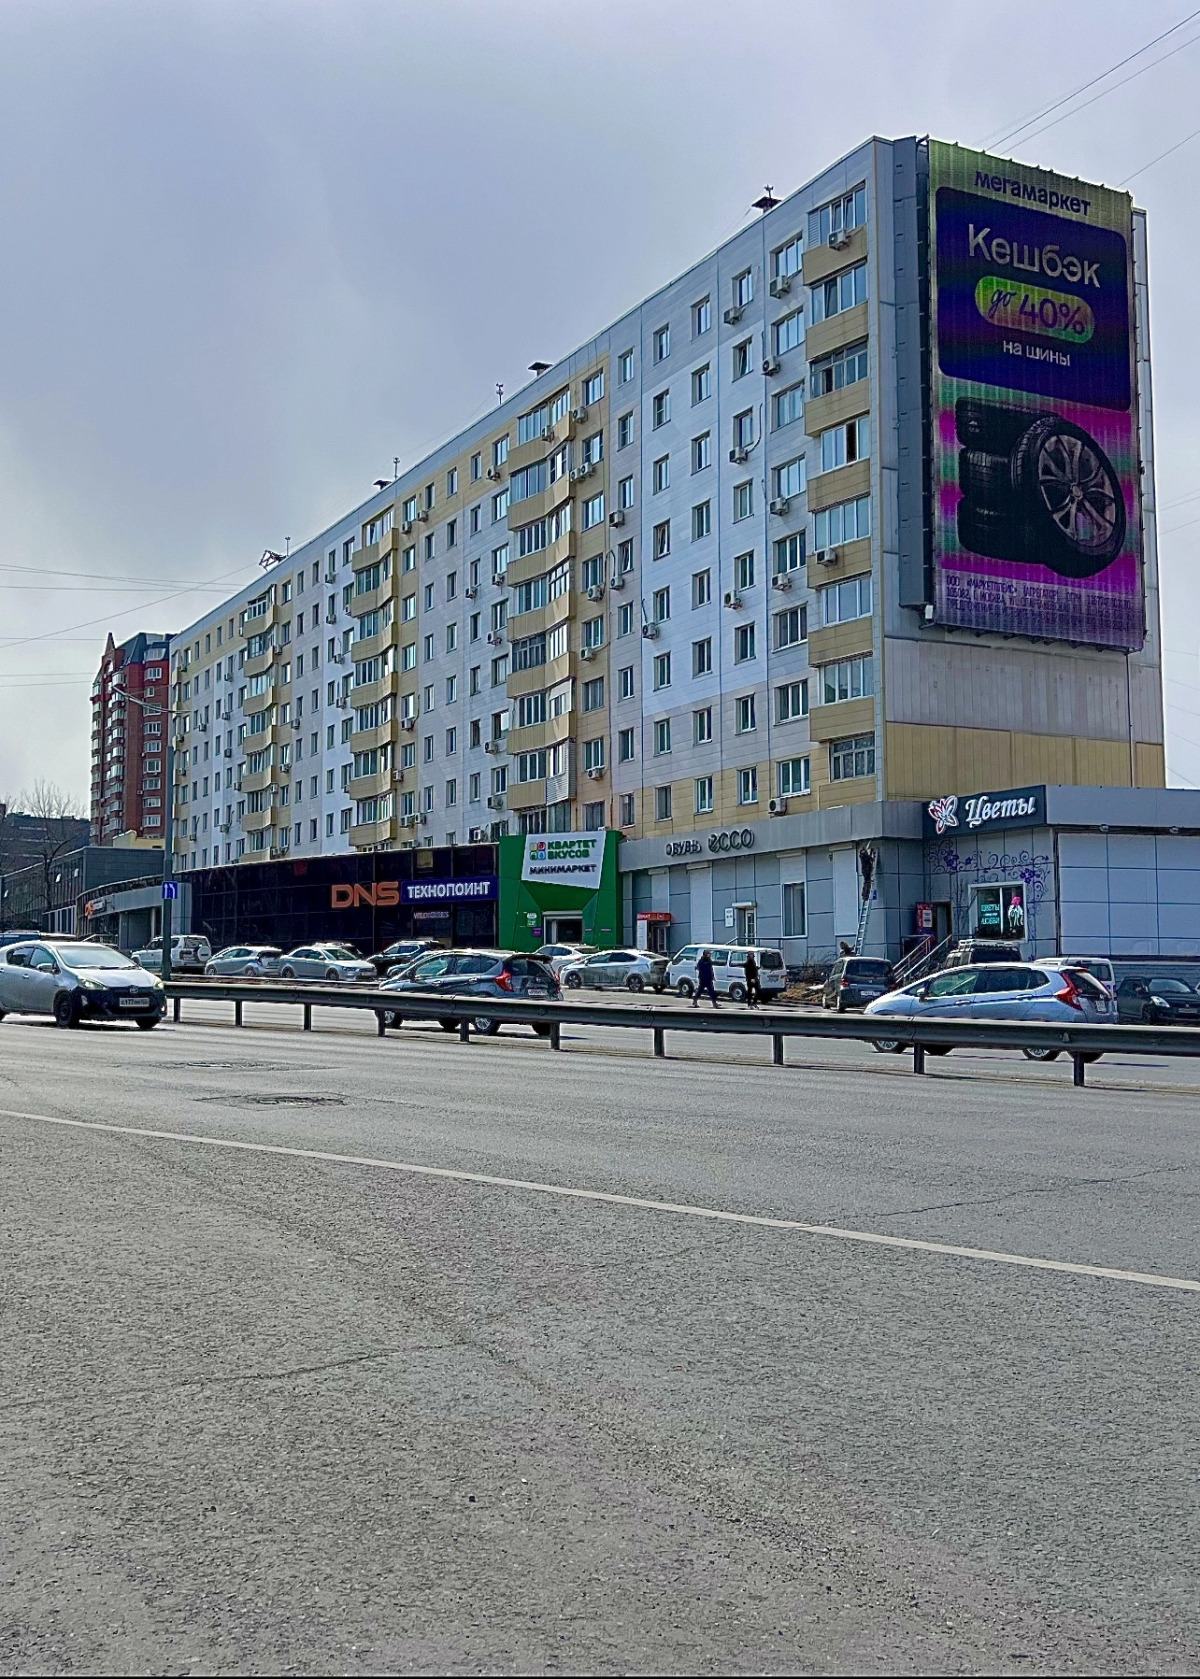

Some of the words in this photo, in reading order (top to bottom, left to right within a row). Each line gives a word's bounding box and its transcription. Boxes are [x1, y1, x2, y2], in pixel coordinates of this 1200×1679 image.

[974, 170, 1092, 216] мегамаркет
[968, 223, 1101, 288] Кешбэк
[988, 288, 1017, 319] до
[1019, 294, 1087, 336] 40%
[1003, 340, 1022, 355] на
[1026, 344, 1071, 367] шины
[965, 796, 1036, 828] Цветы
[547, 838, 597, 850] КВАРТЕТ
[547, 849, 590, 860] ВКУСОВ
[666, 839, 702, 857] ОБУВЬ
[529, 863, 597, 876] МИНИМАРКЕТ
[331, 881, 400, 908] DNS
[407, 882, 491, 899] ТЕХНОПОИНТ
